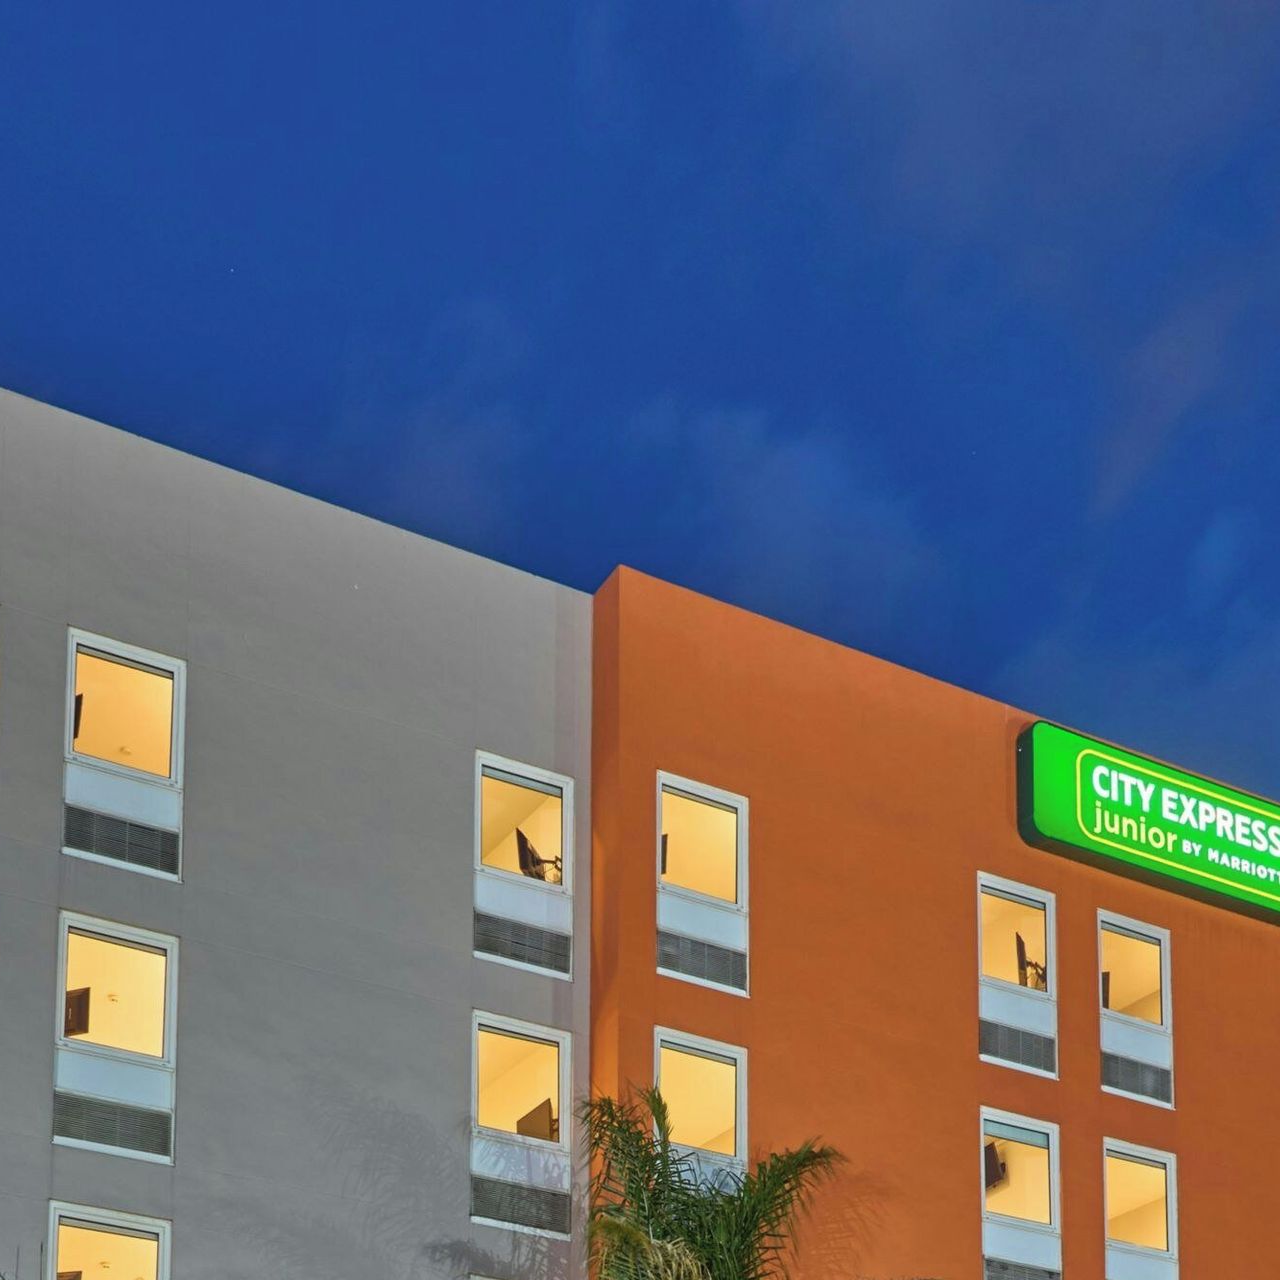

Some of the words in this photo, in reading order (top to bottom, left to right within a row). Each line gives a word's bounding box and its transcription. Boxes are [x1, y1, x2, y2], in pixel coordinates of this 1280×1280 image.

[1092, 765, 1155, 812] CITY
[1093, 800, 1177, 853] junior
[1182, 839, 1202, 857] BY
